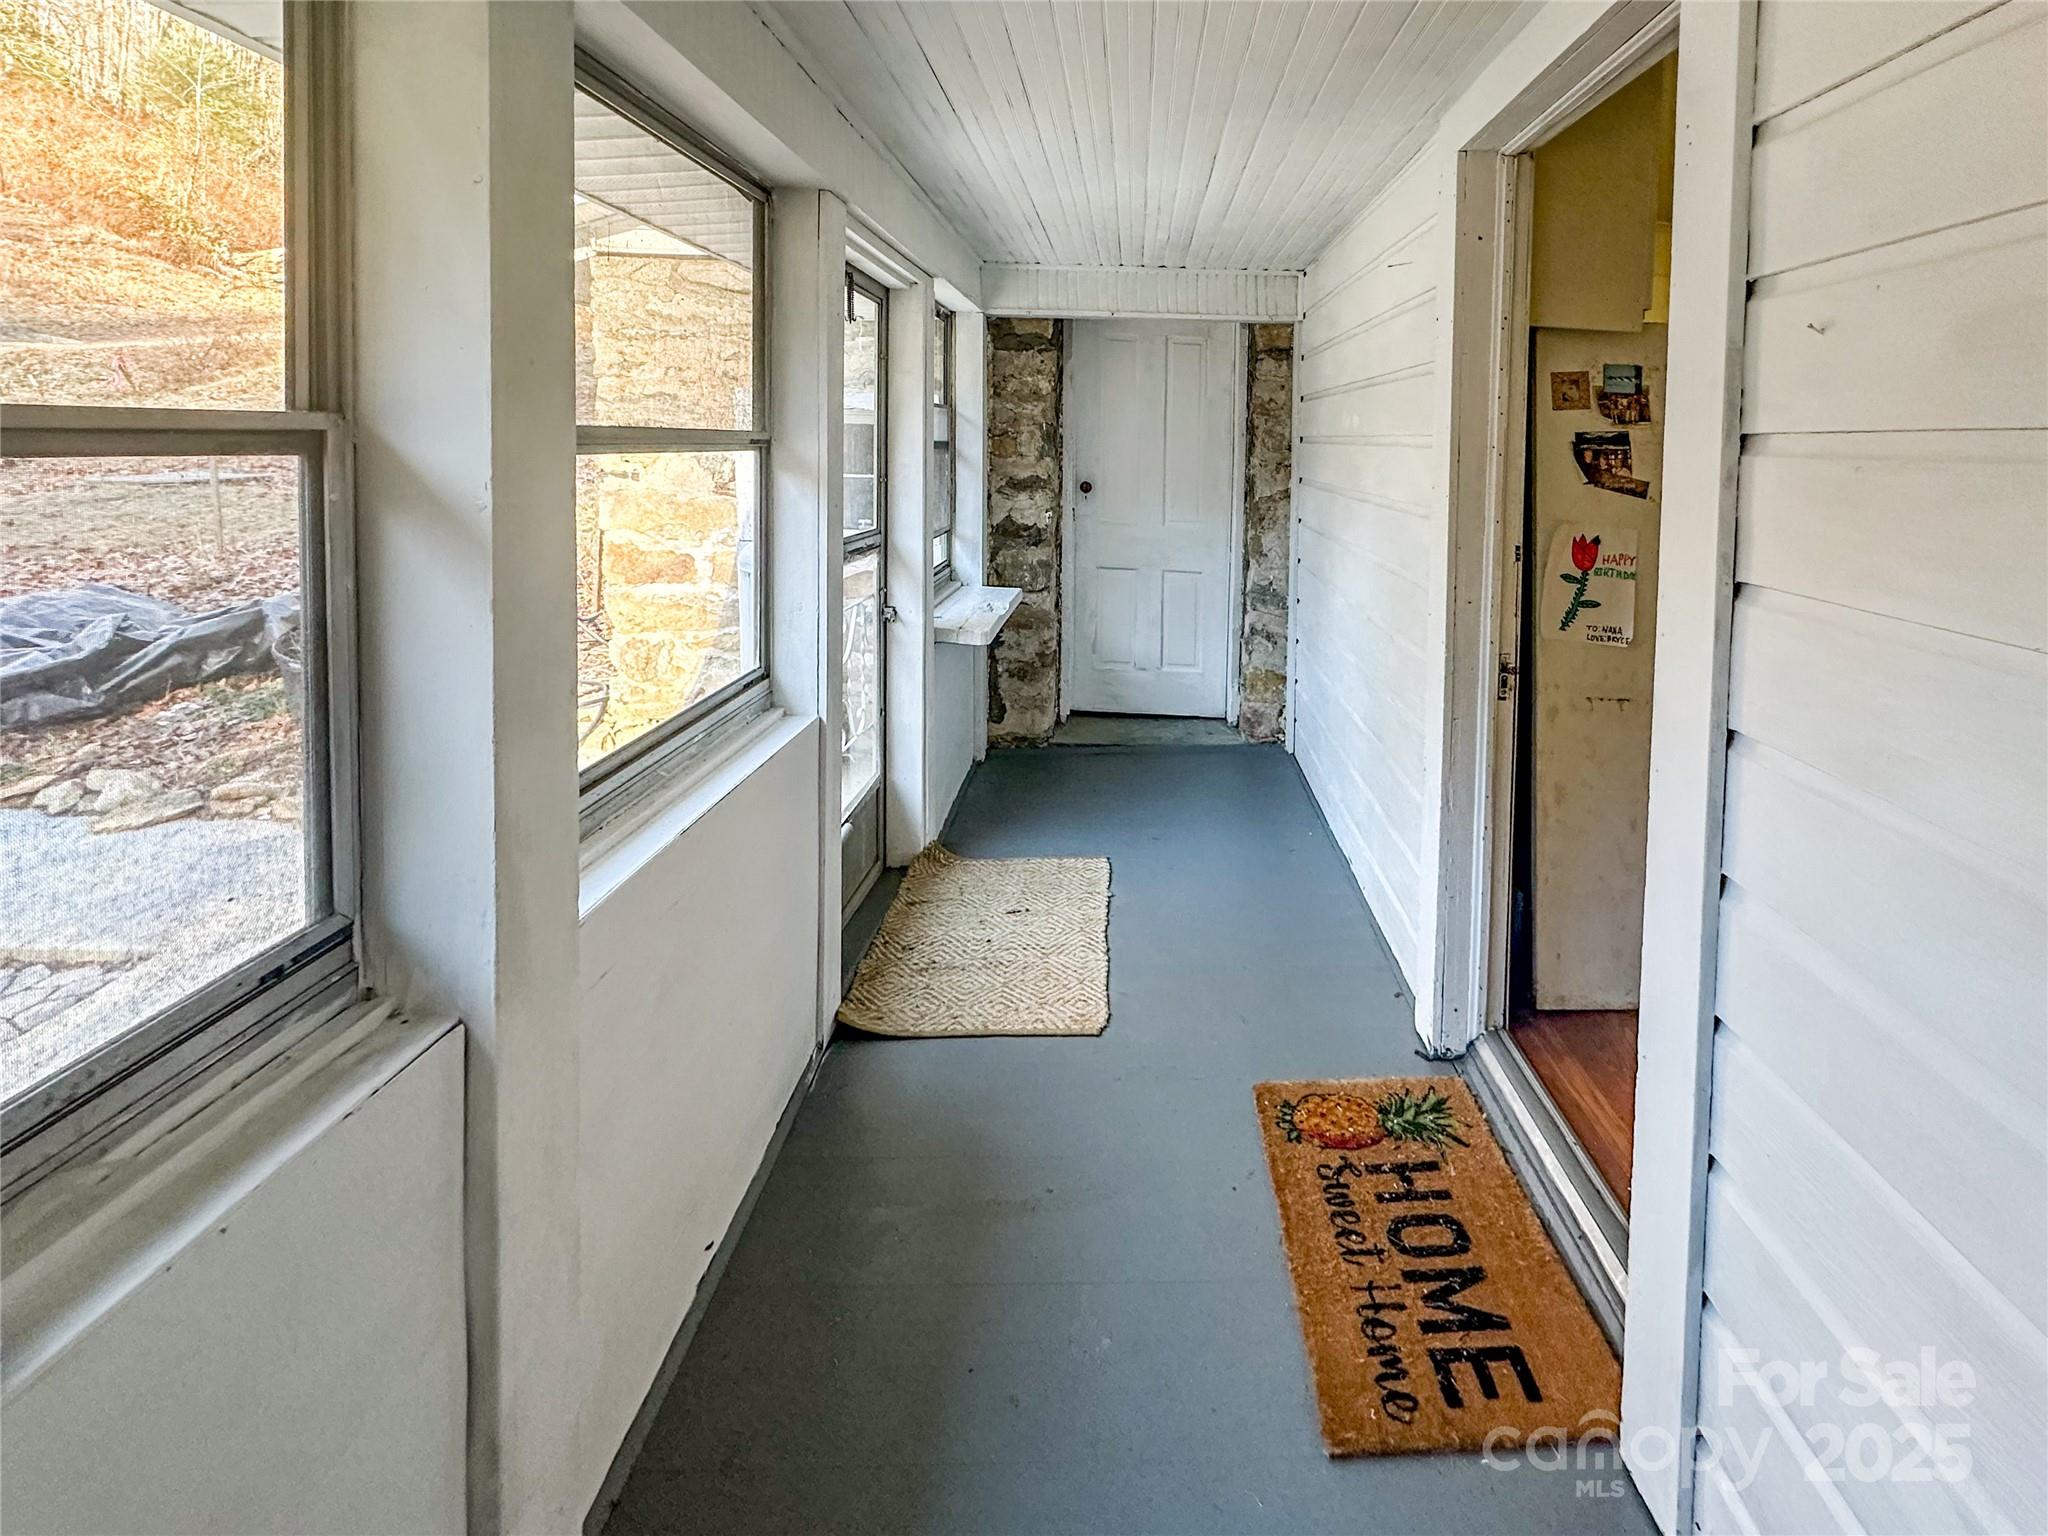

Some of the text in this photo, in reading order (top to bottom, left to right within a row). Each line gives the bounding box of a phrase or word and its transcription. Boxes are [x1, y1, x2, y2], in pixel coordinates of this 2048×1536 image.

[1602, 553, 1637, 566] HAPPY
[1317, 1156, 1420, 1425] Sweet Home
[1365, 1160, 1544, 1409] HOME
